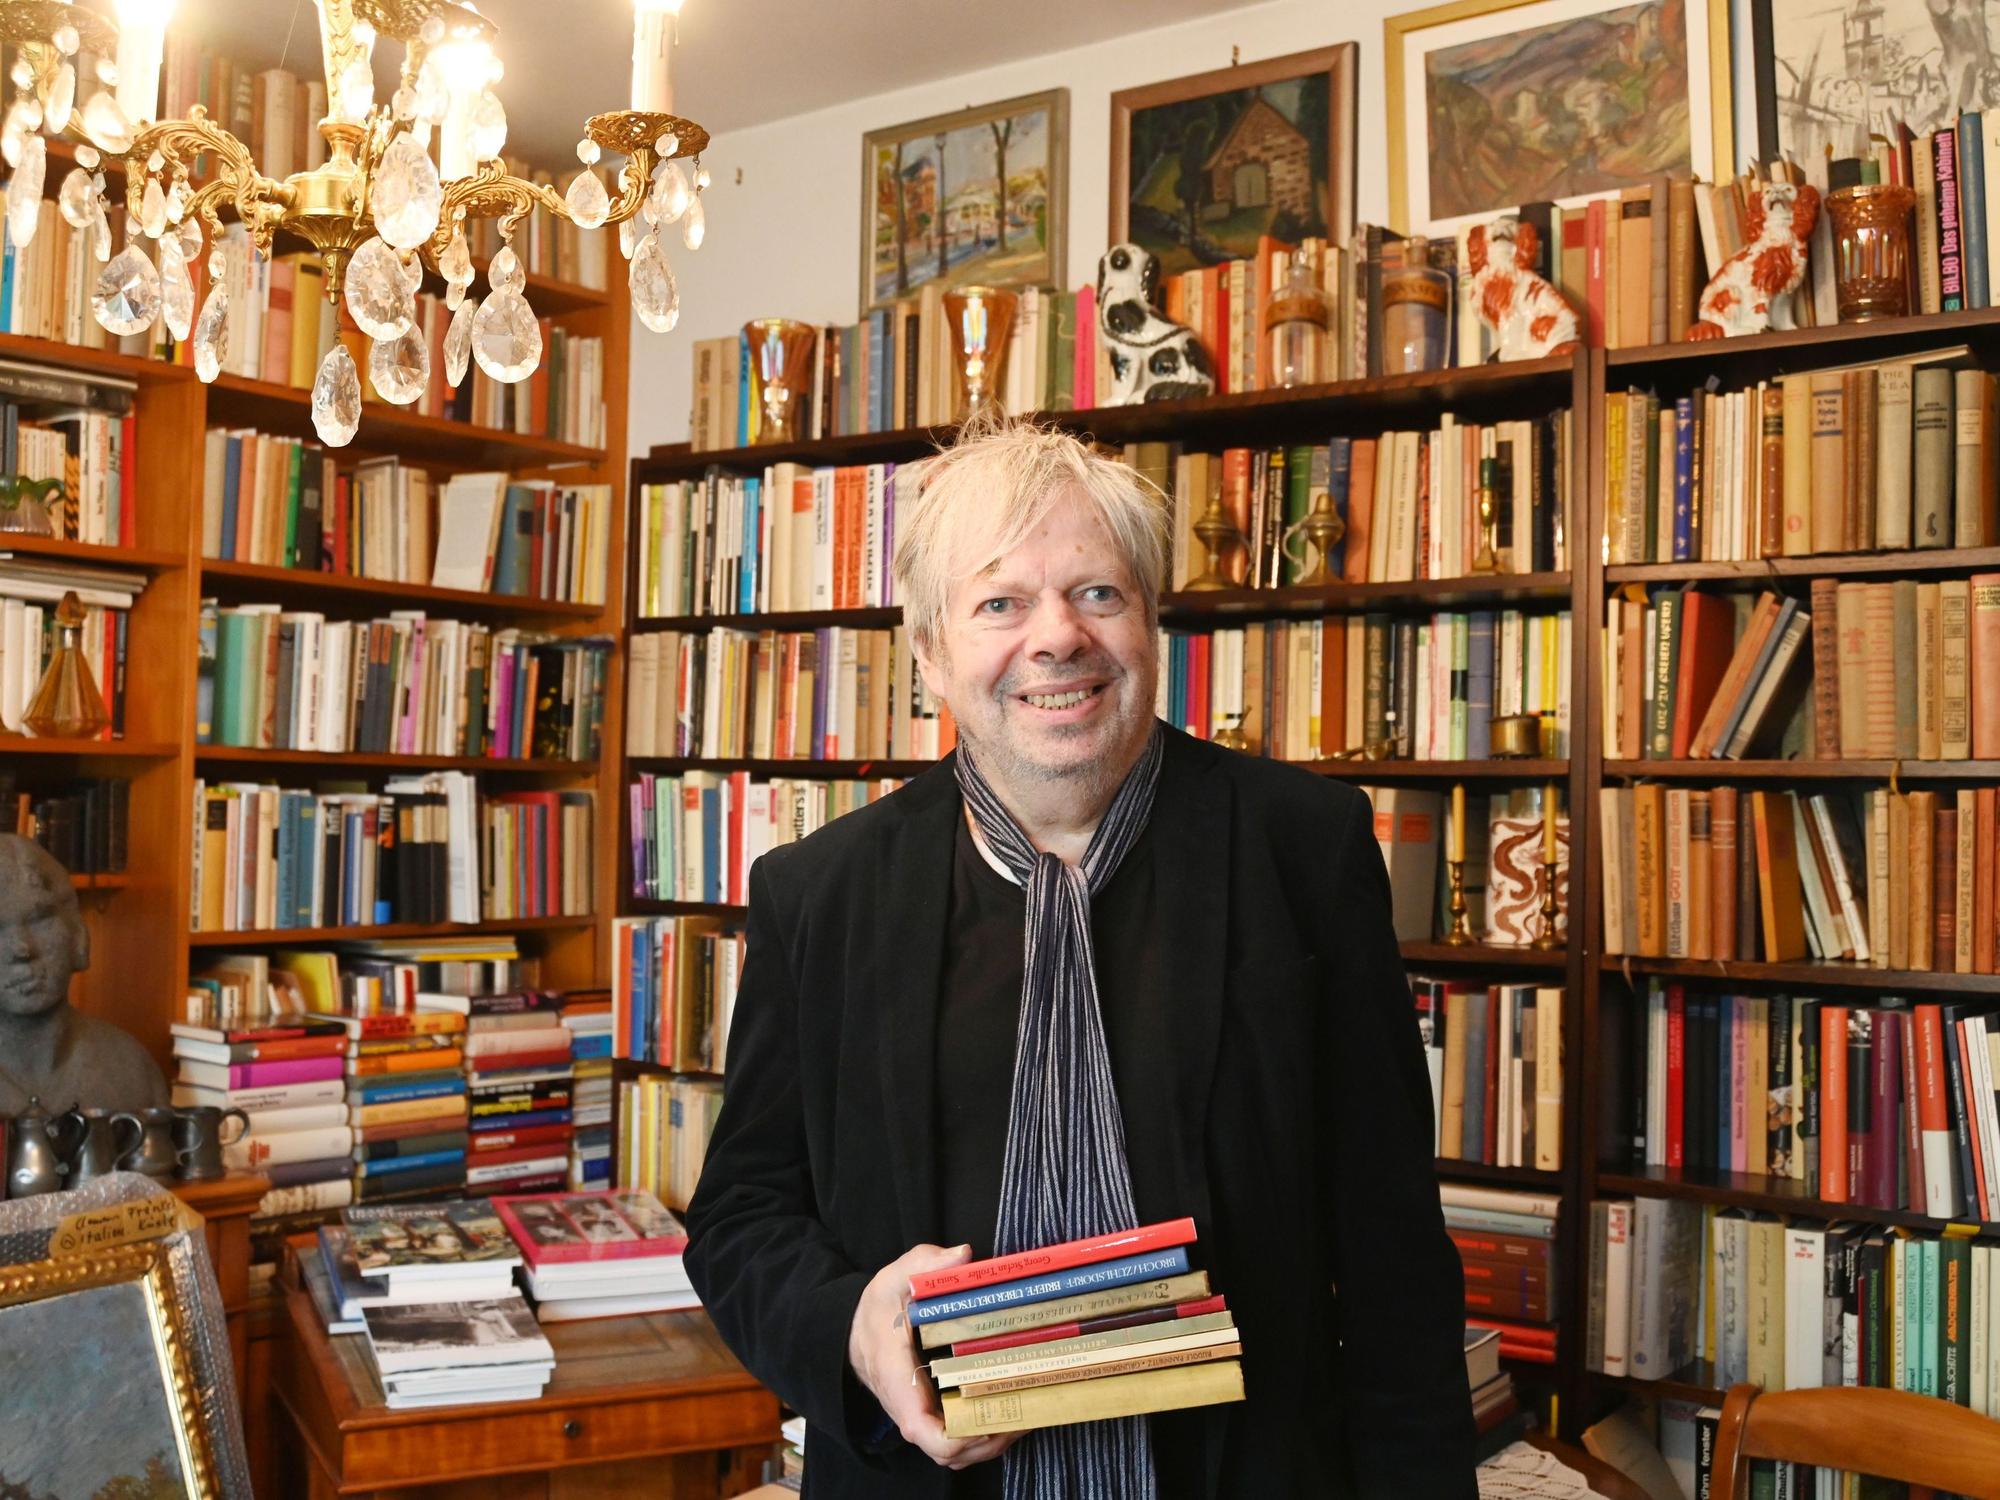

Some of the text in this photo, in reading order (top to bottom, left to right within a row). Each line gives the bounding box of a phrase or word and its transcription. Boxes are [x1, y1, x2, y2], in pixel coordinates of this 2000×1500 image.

[1935, 133, 1960, 294] BILBO Das geheime Kabinett
[924, 1254, 1051, 1289] Georg Stefan Troller Santa Fe
[1025, 1280, 1062, 1297] BRIEFE
[918, 1294, 996, 1319] DEUTSCHLAND
[973, 1357, 996, 1368] WELT
[1014, 1350, 1038, 1362] ENDE
[1185, 1350, 1212, 1362] RUDOLF
[1701, 1425, 1711, 1466] fenster
